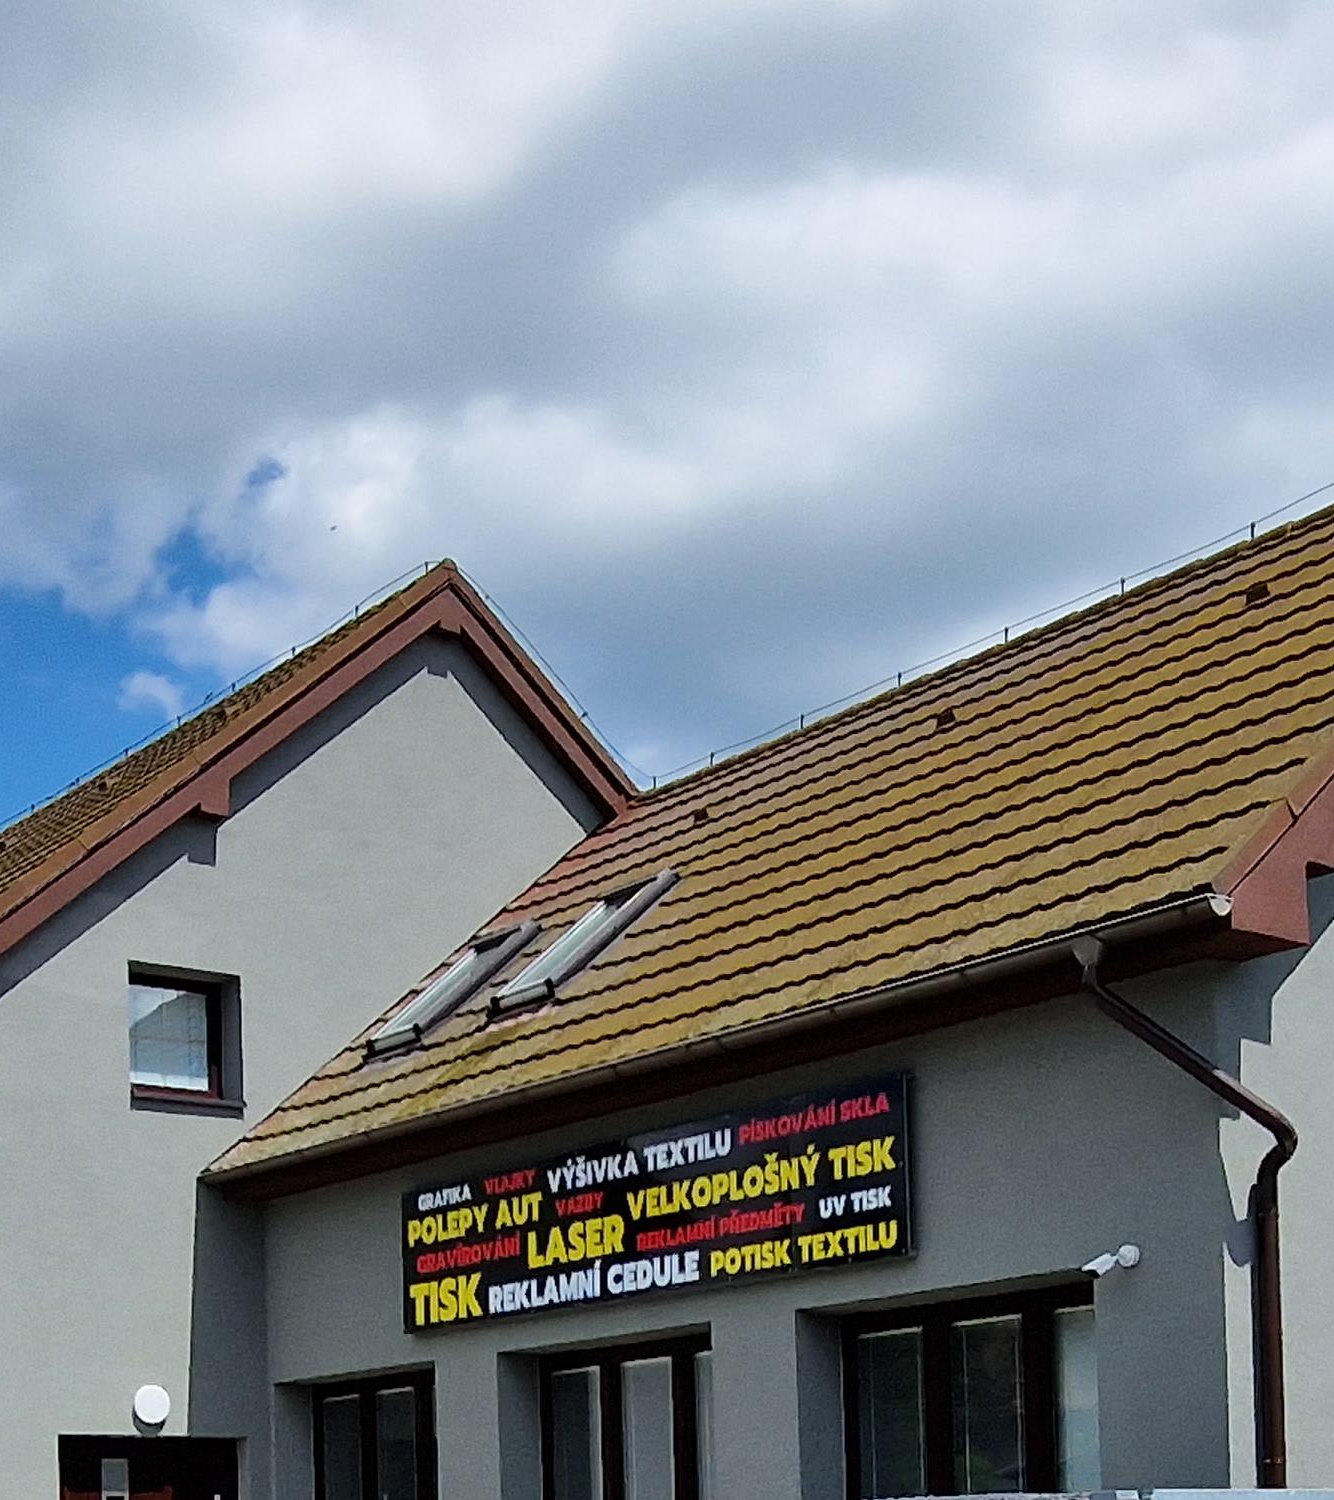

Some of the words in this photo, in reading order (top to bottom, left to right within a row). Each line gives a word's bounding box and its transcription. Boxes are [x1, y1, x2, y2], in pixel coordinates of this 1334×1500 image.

[739, 1099, 835, 1145] PÍSKOVÁNÍ
[840, 1092, 890, 1119] SKLA
[484, 1169, 536, 1195] VLAJKY
[547, 1151, 638, 1193] VÝŠIVKA
[643, 1128, 731, 1172] TEXTILU
[627, 1144, 821, 1220] VELKOPLOŠNÝ
[829, 1135, 896, 1180] TISK
[408, 1203, 488, 1247] POLEPY
[495, 1191, 543, 1229] AUT
[418, 1184, 471, 1211] GRAFIKA
[819, 1195, 845, 1219] UV
[850, 1186, 891, 1212] TISK
[417, 1230, 520, 1273] GRAVÍROVÁNÍ
[528, 1214, 624, 1269] LASER
[636, 1215, 715, 1251] REKLAMNÍ
[720, 1203, 805, 1236] PŘEDMĚTY
[710, 1238, 792, 1277] POTISK
[798, 1220, 898, 1263] TEXTILU
[410, 1273, 483, 1325] TISK
[489, 1260, 600, 1313] REKLAMNÍ
[607, 1250, 700, 1294] CEDULE
